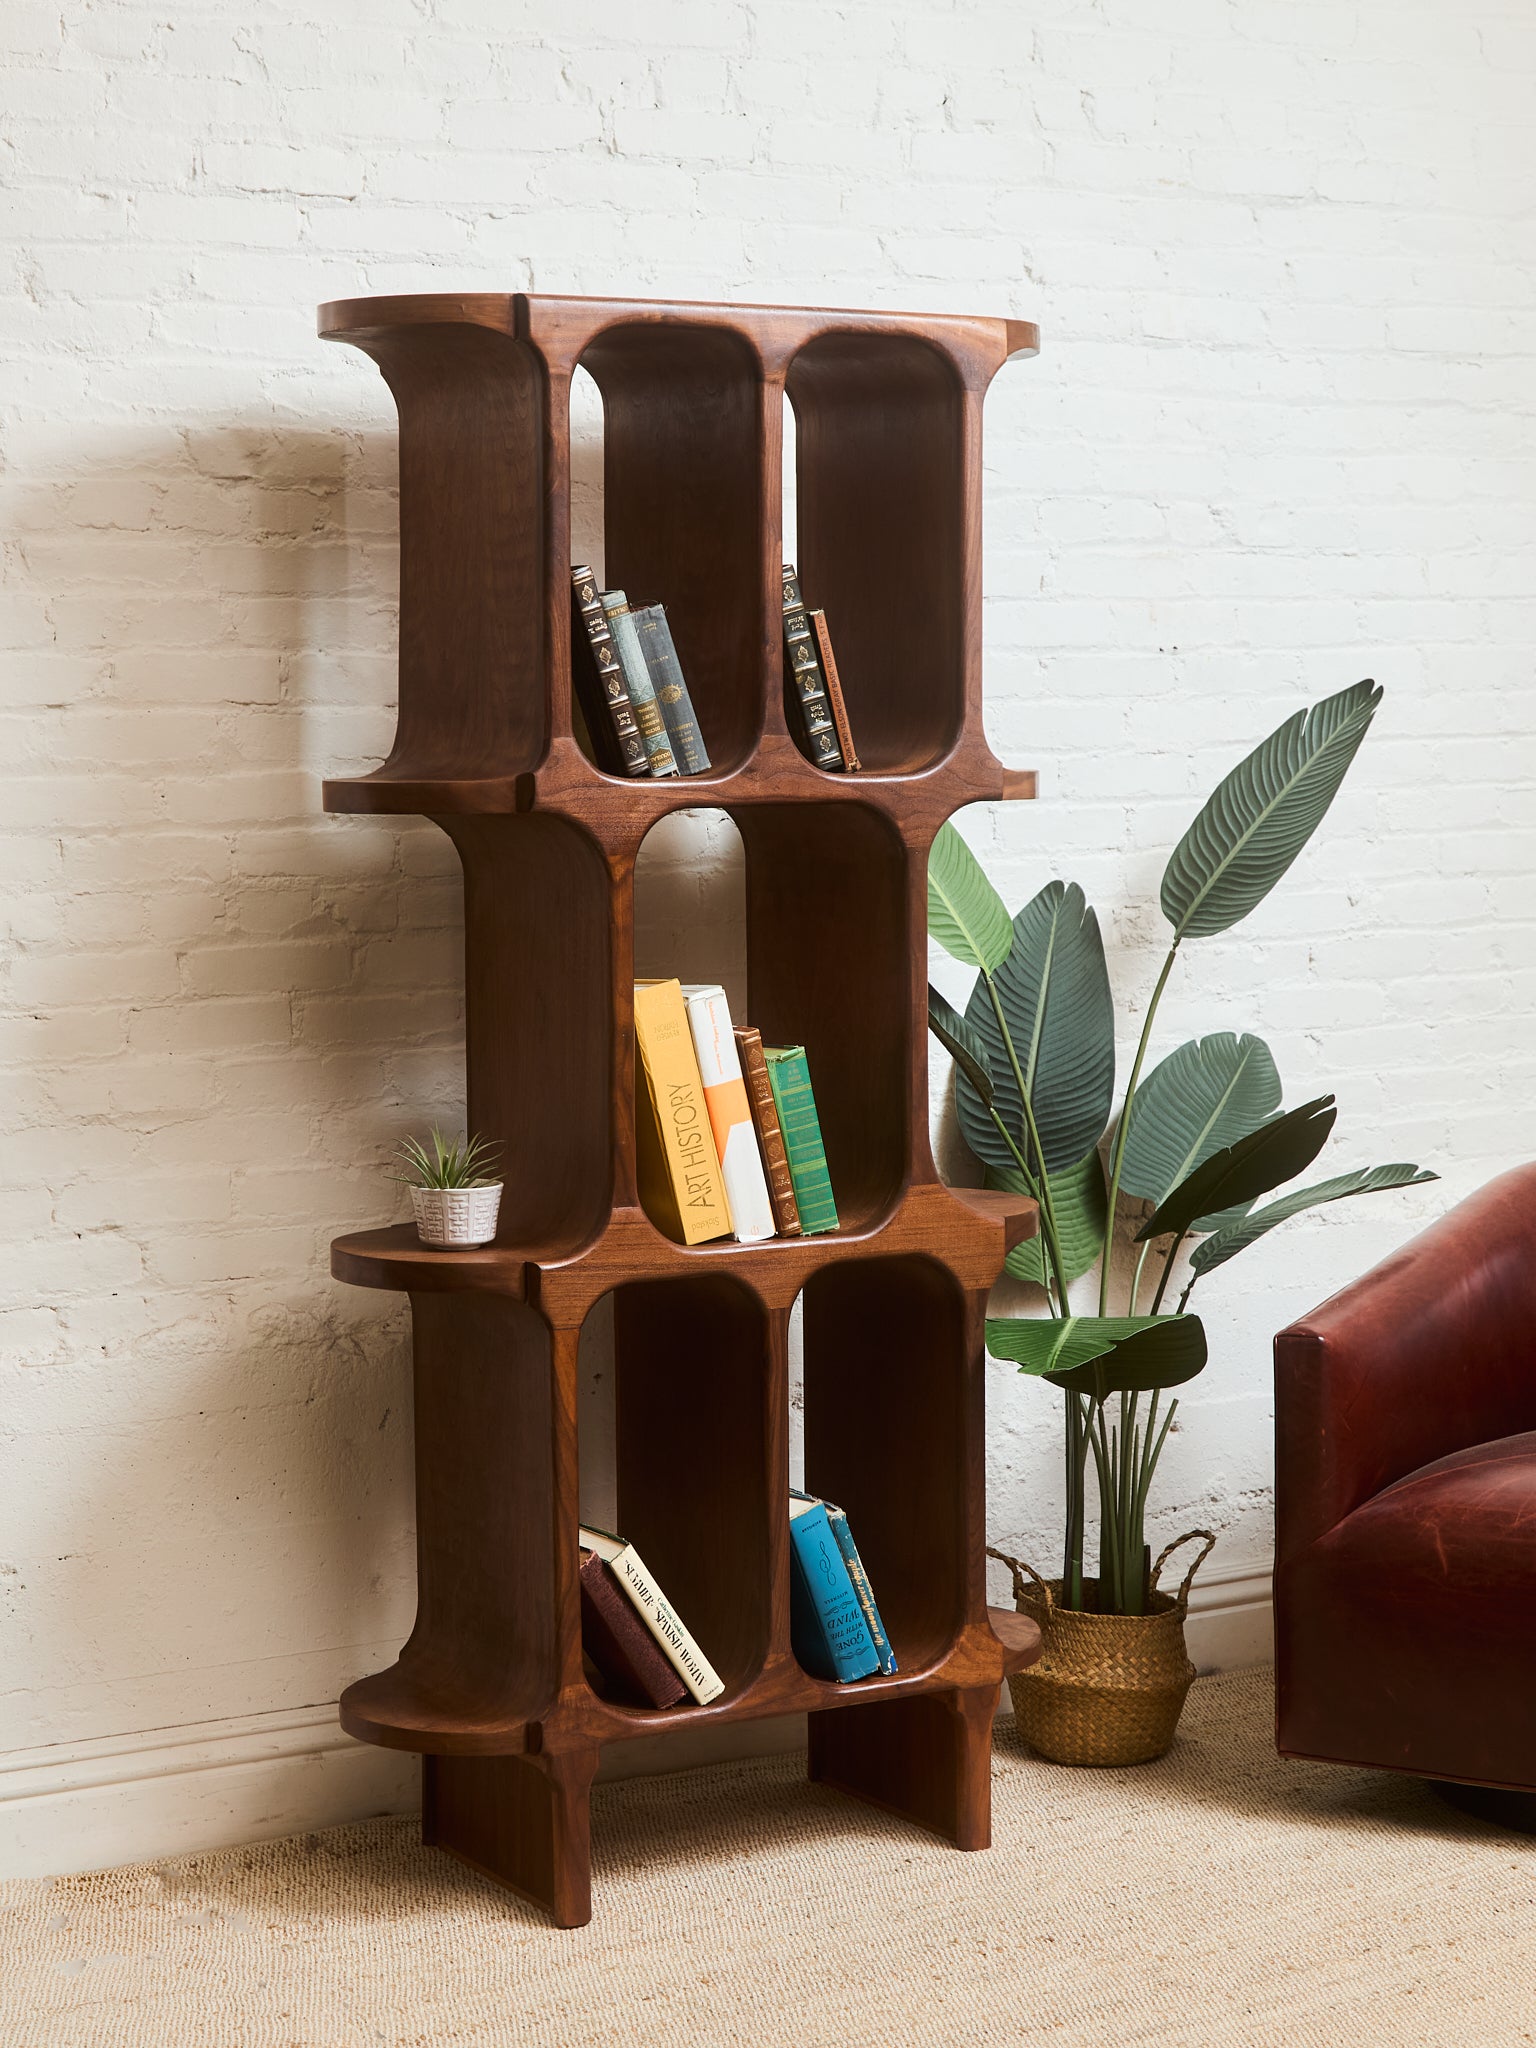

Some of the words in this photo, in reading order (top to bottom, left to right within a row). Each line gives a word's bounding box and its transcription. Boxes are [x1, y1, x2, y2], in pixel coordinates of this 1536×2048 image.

[822, 638, 834, 668] READERS
[829, 670, 838, 688] BASIC
[666, 1083, 707, 1169] HISTORY
[684, 1173, 716, 1208] ART
[691, 1216, 721, 1232] Stokstad
[824, 1590, 849, 1605] MITCHELL
[827, 1608, 860, 1630] WIND
[846, 1621, 864, 1634] WITH
[831, 1629, 846, 1641] THE
[837, 1630, 865, 1651] GONE
[874, 1633, 884, 1647] the
